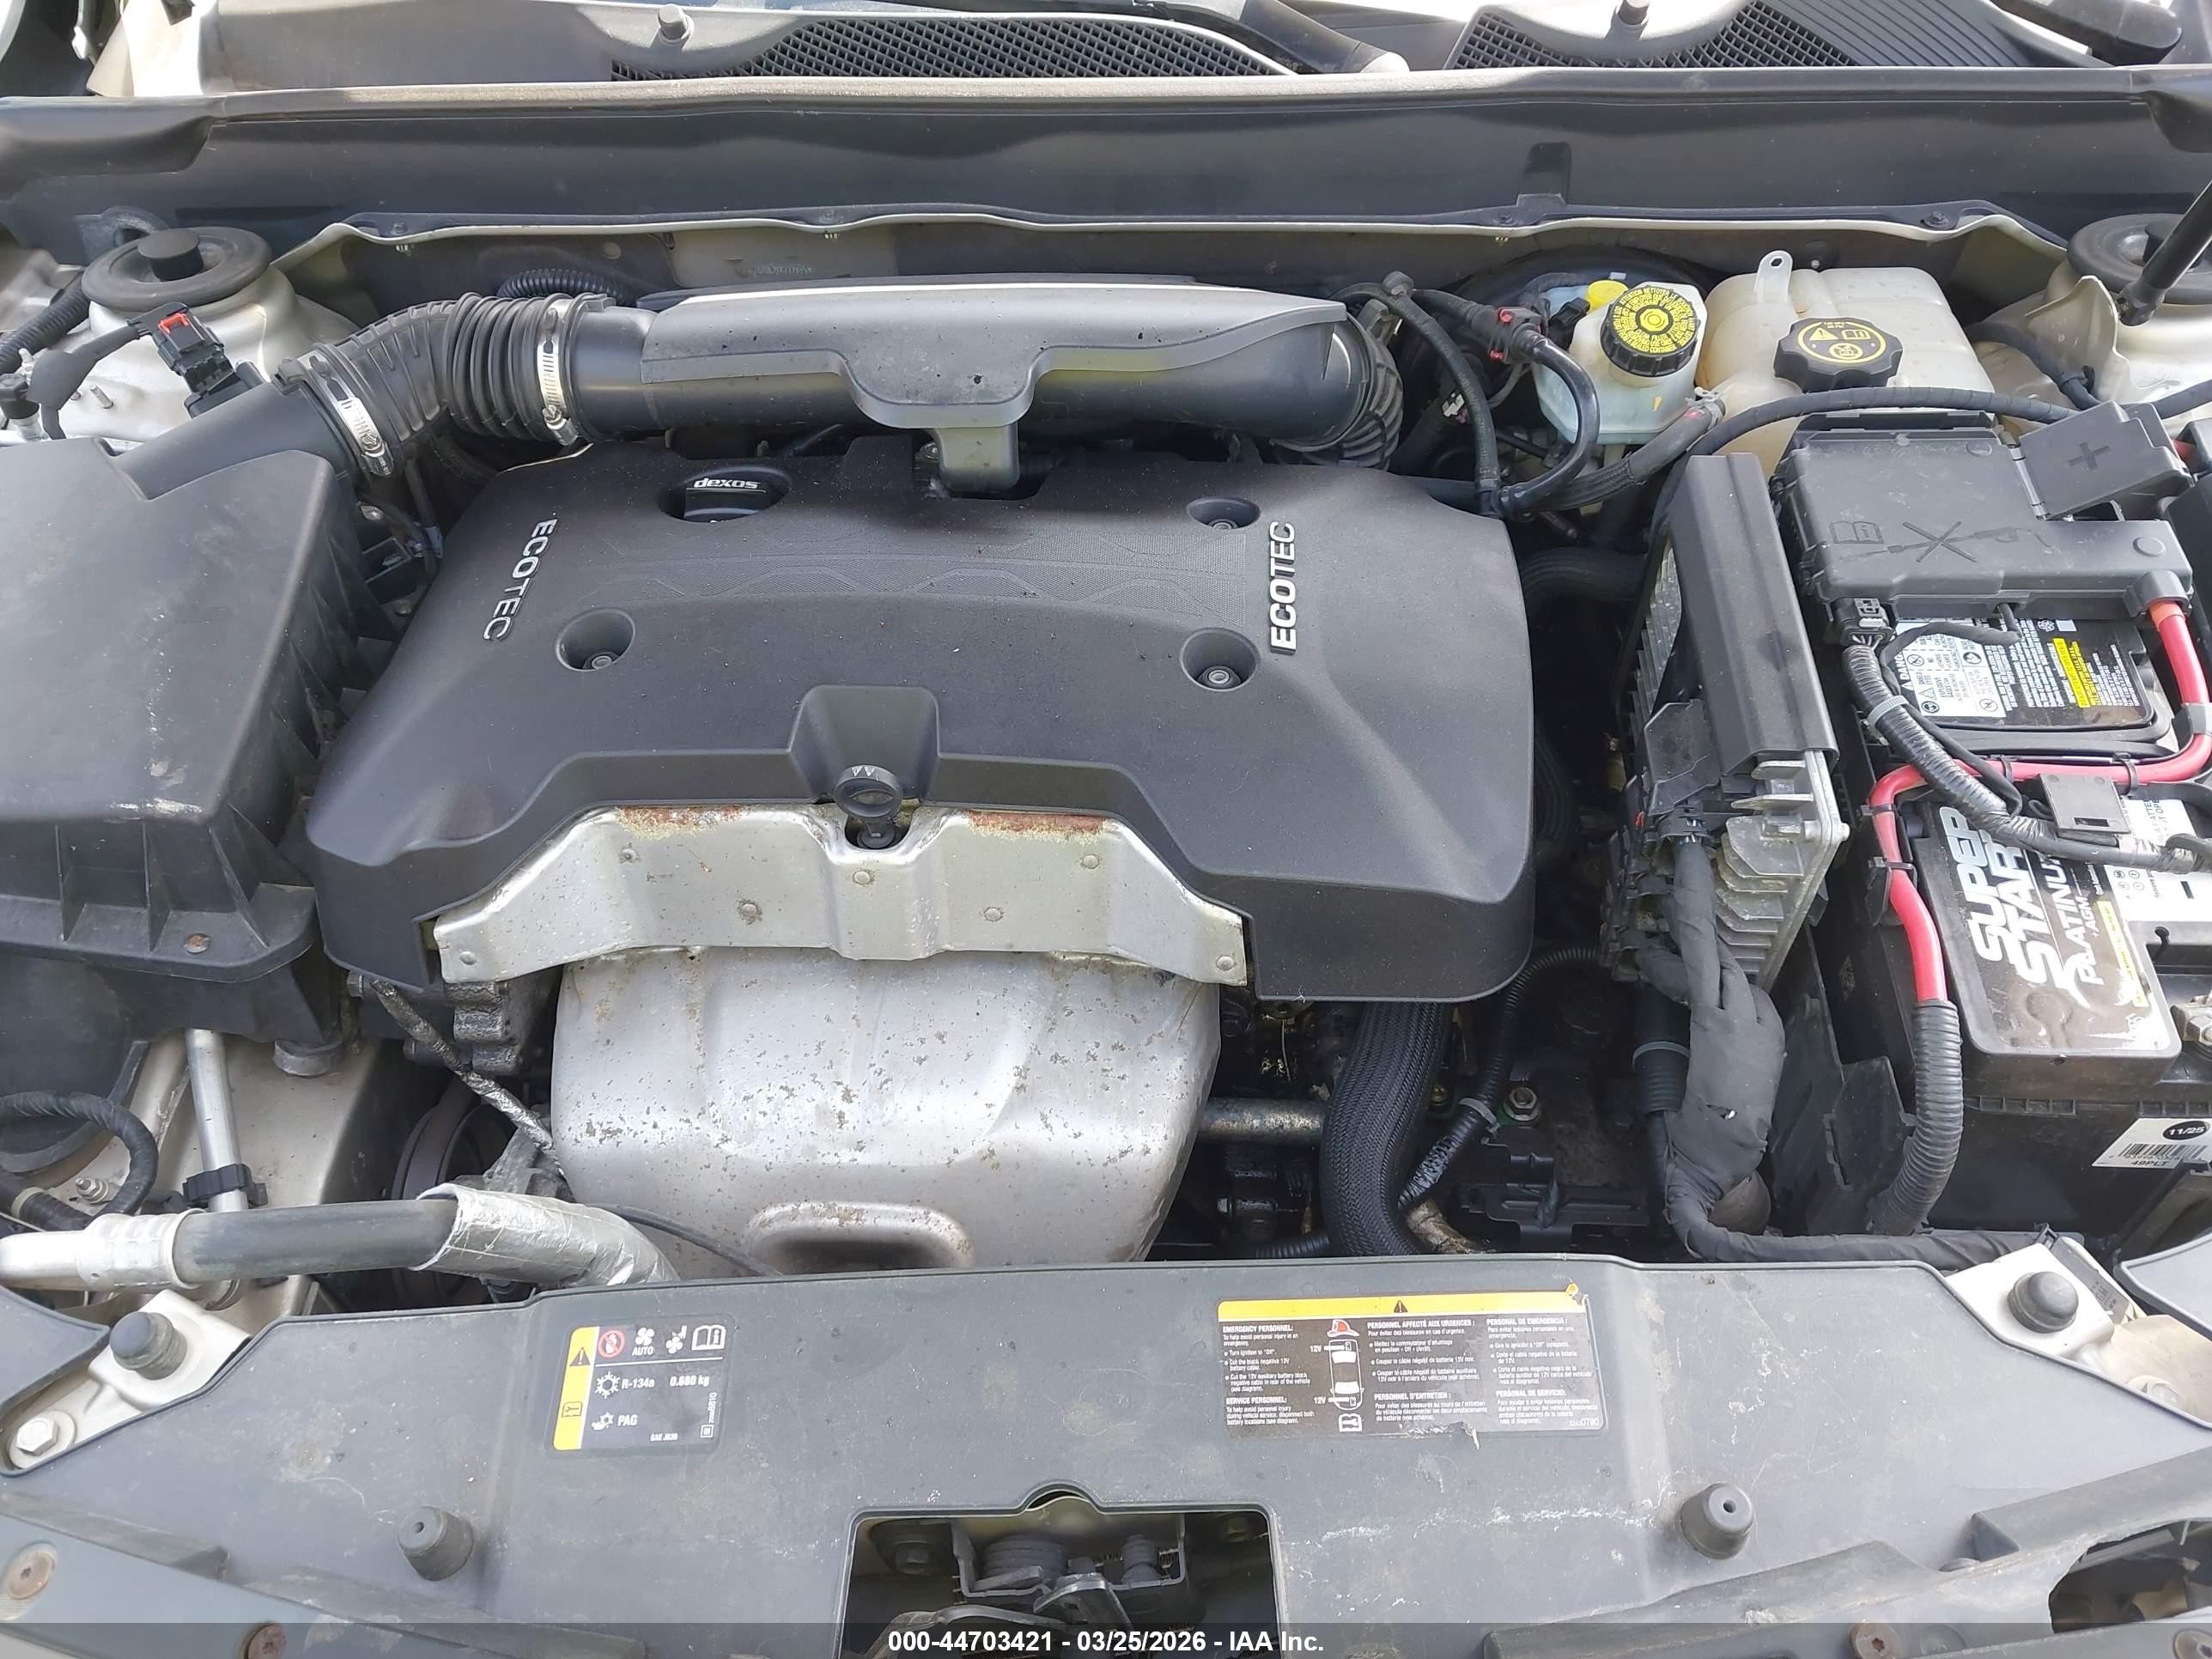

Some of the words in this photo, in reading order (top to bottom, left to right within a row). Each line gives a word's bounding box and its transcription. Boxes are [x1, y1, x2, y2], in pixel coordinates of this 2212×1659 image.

[693, 478, 761, 489] dexos
[483, 518, 559, 641] ECOTEC
[1270, 521, 1296, 652] ECOTEC
[2075, 896, 2100, 933] AGM
[2169, 1126, 2205, 1135] 11/25
[632, 1346, 653, 1356] AUTO
[621, 1378, 655, 1389] R-134a
[698, 1375, 710, 1387] kg
[617, 1414, 638, 1427] PAG
